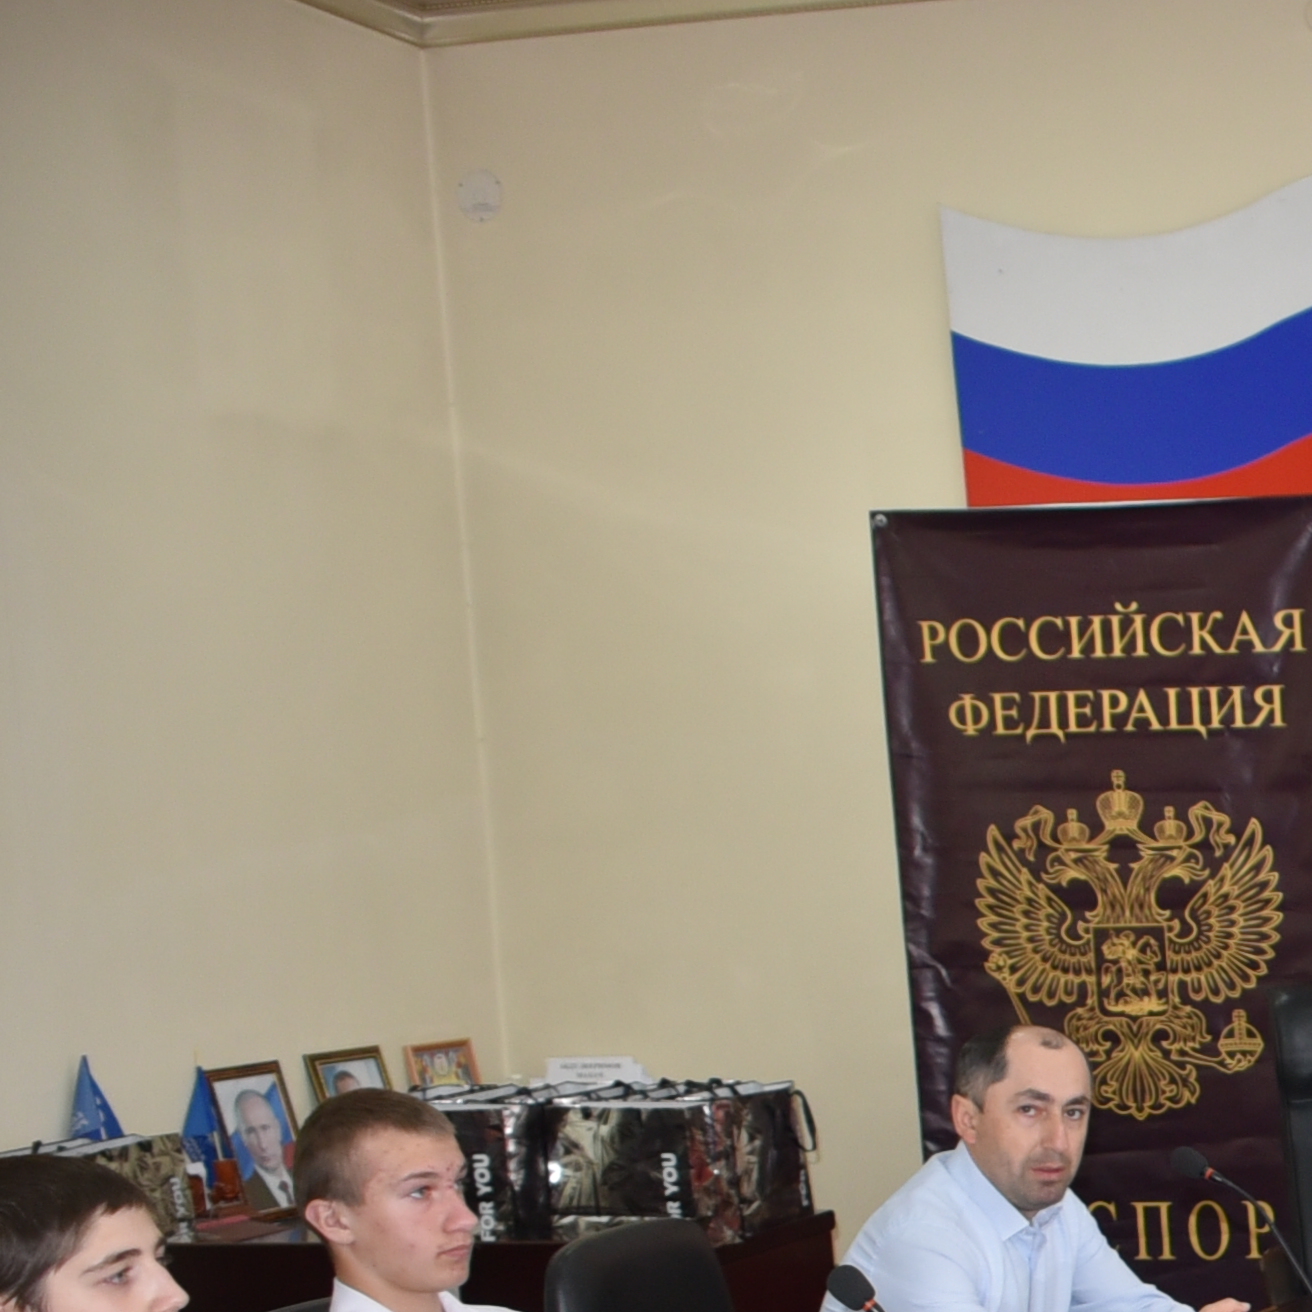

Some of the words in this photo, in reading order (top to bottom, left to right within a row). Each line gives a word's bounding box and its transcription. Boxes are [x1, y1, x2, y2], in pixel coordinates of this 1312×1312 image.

[918, 600, 1306, 664] РОССИЙСКАЯ
[948, 683, 1287, 744] ФЕДЕРАЦИЯ
[471, 1153, 493, 1197] YOU
[660, 1152, 681, 1197] YOU
[479, 1201, 496, 1242] FOR
[1088, 1199, 1275, 1261] ПОР
